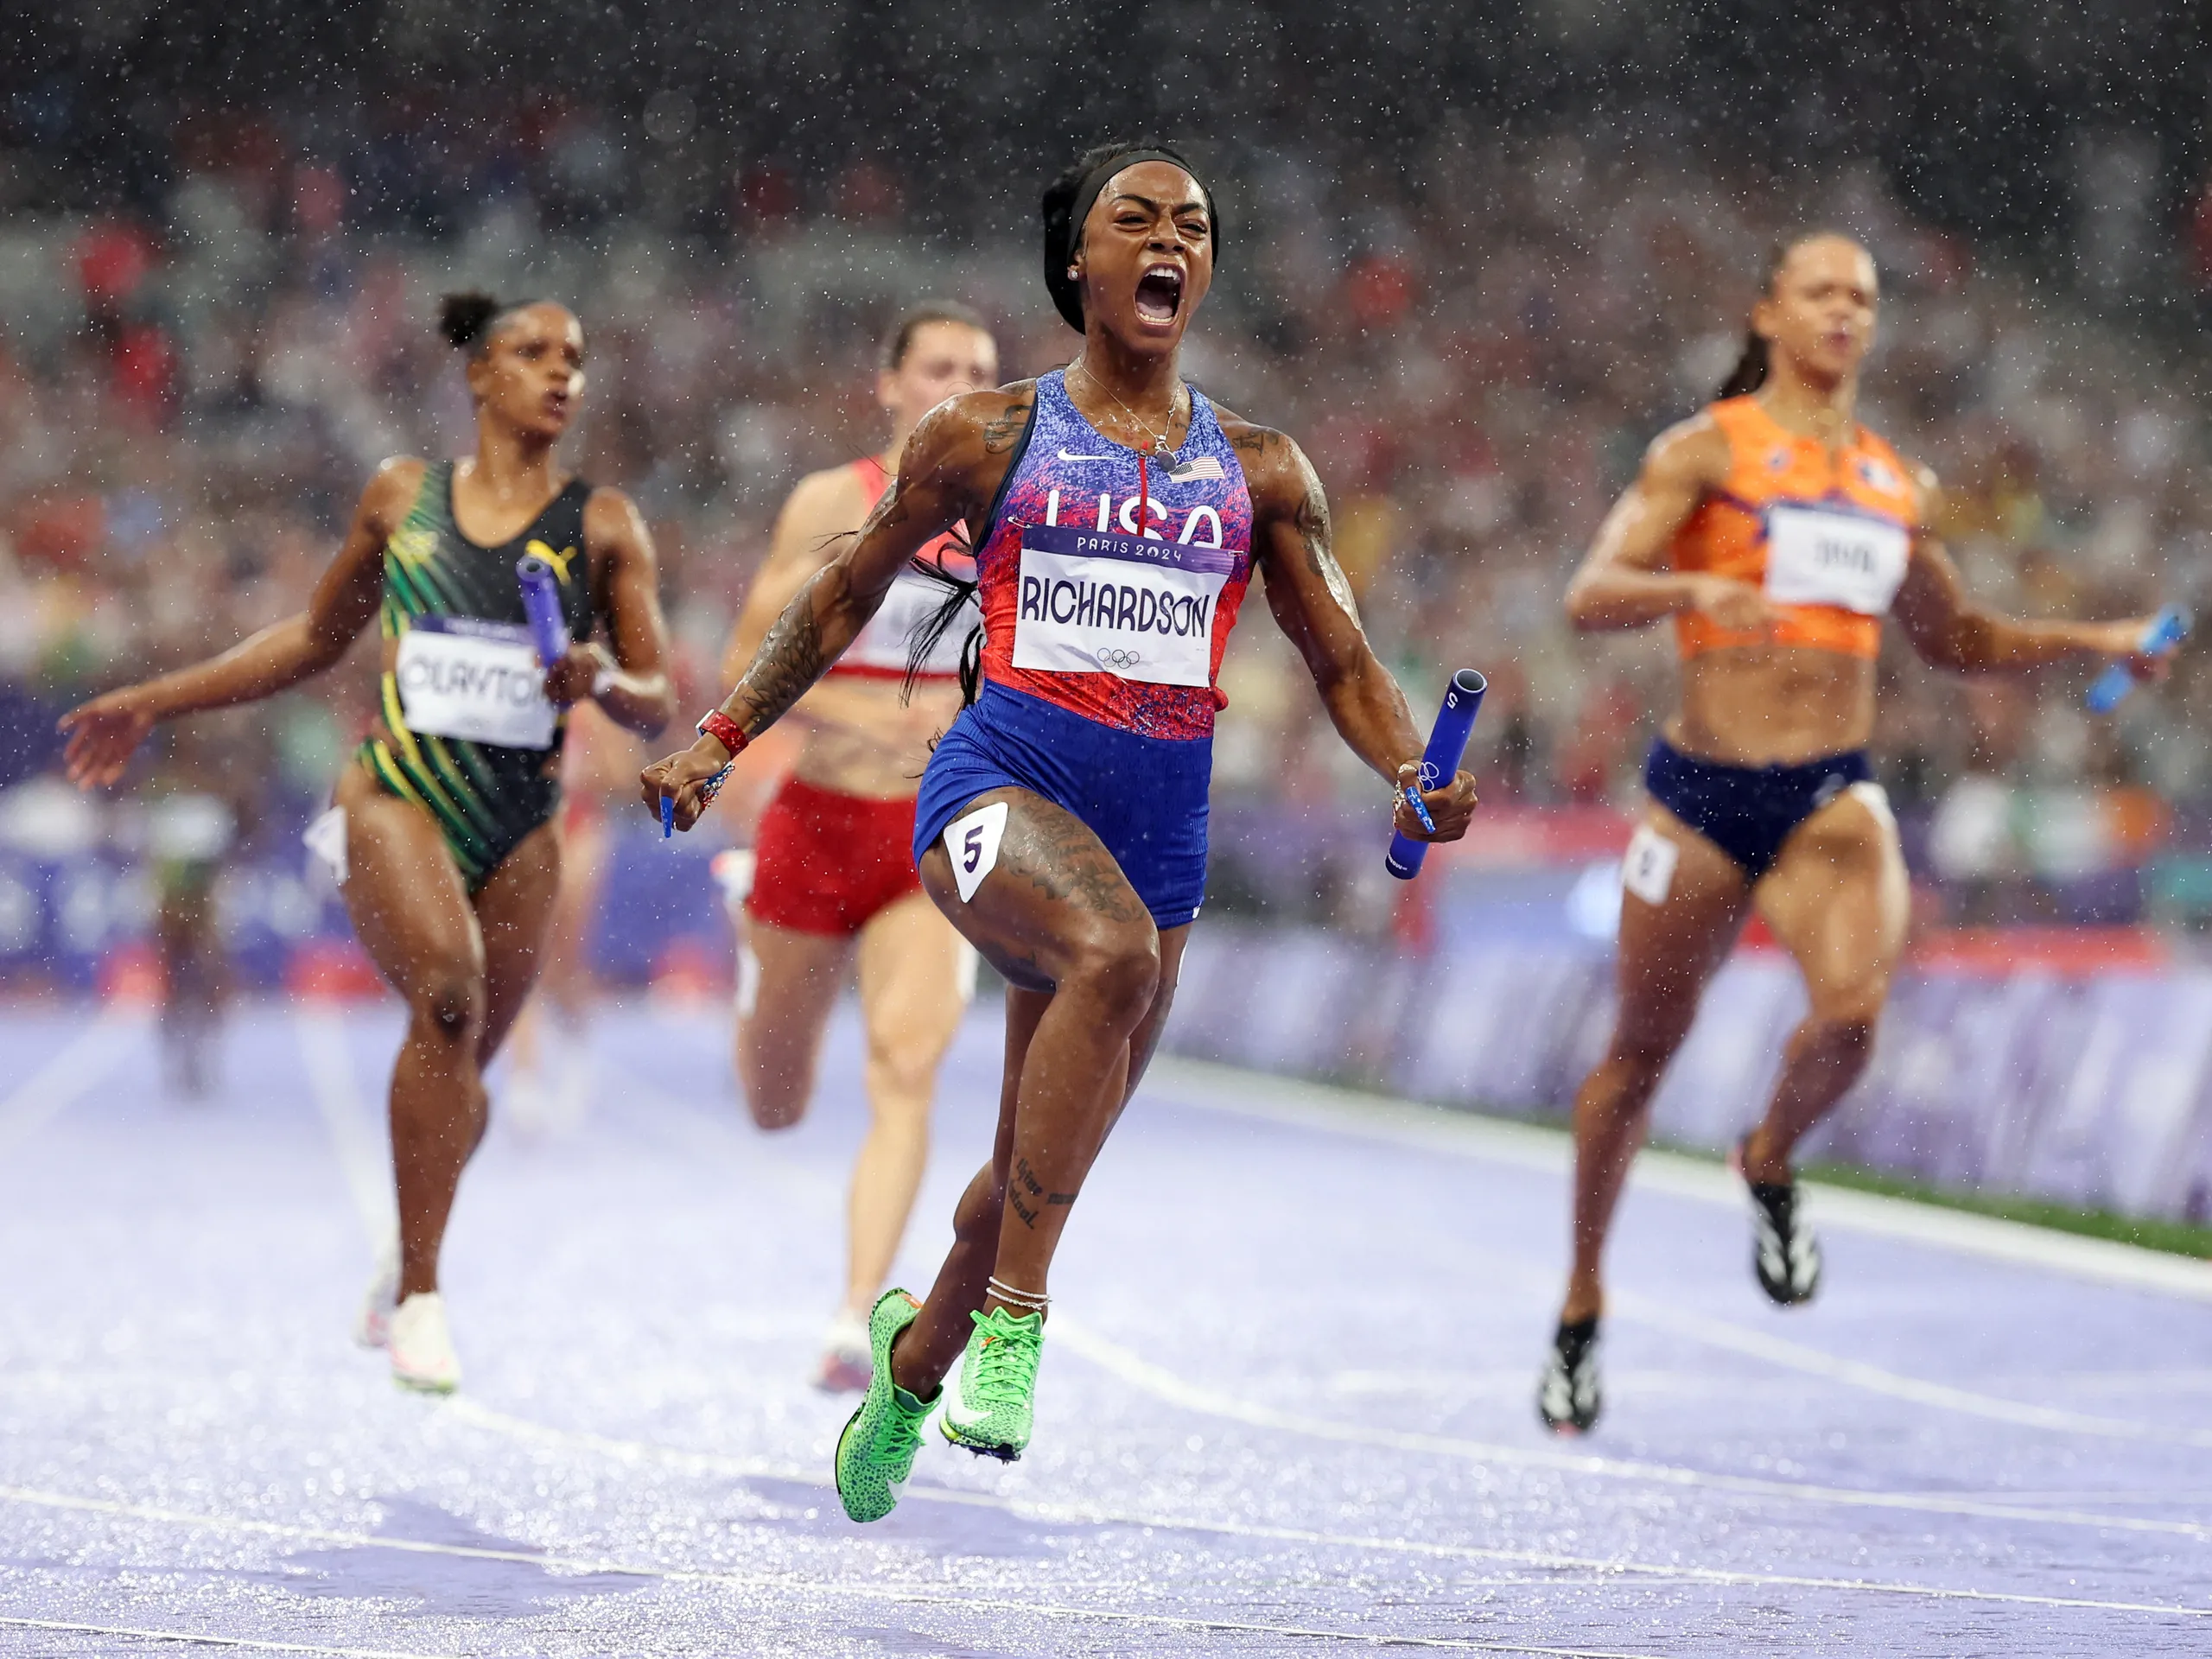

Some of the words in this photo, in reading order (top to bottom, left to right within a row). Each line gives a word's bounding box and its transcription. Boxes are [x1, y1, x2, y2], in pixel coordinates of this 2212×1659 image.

[1077, 536, 1128, 554] PARIS
[1135, 543, 1182, 563] 2024
[1020, 575, 1211, 639] RICHARDSON
[963, 824, 984, 874] 5
